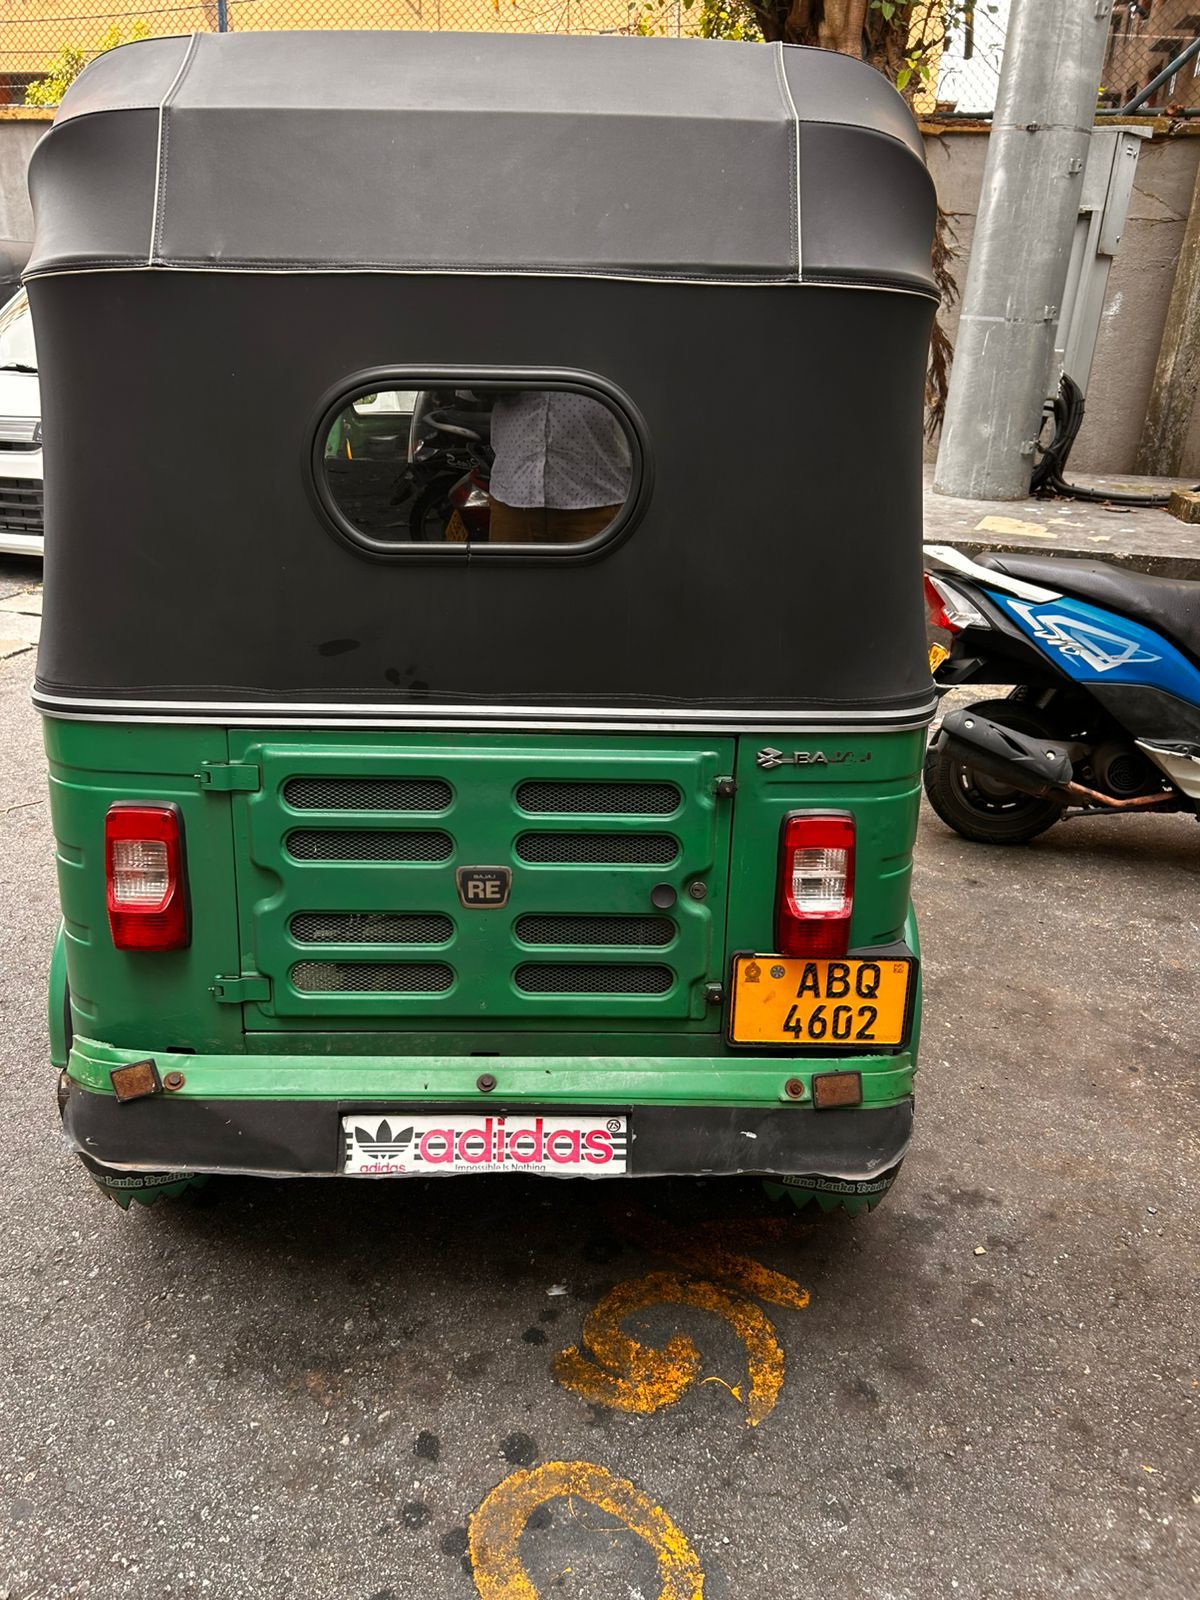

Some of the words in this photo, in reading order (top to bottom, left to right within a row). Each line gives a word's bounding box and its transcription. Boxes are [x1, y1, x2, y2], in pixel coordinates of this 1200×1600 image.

[467, 880, 501, 899] RE
[796, 962, 881, 999] ABQ
[782, 1004, 878, 1040] 4602
[418, 1117, 614, 1164] adidas
[359, 1161, 407, 1173] adidas
[455, 1163, 500, 1171] Impossible
[511, 1163, 546, 1172] Nothing
